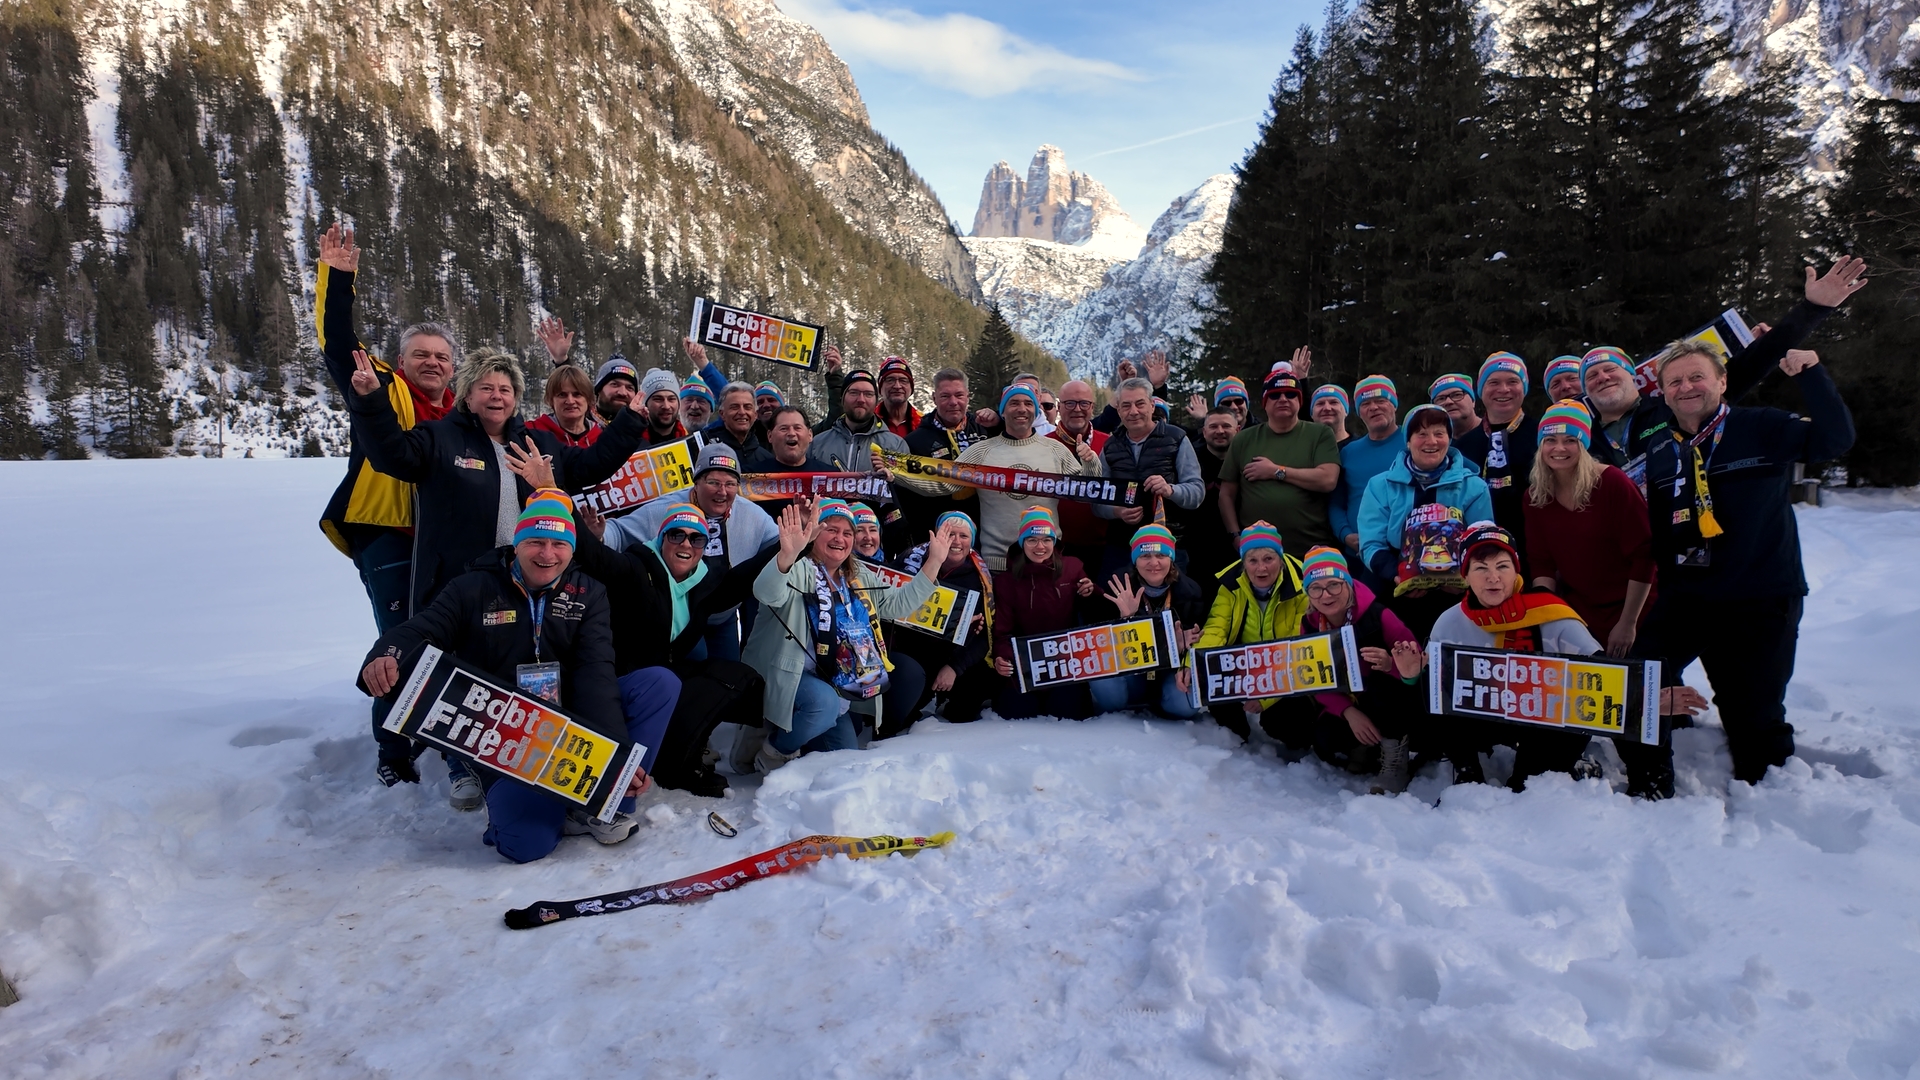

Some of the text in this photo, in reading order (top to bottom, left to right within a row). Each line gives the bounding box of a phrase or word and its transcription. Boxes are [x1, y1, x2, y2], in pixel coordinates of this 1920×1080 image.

[723, 311, 803, 342] Bobteam
[582, 450, 677, 490] bteam
[907, 459, 1007, 489] Bobteam
[1013, 472, 1117, 501] Friedrich
[1043, 628, 1139, 657] Bobteam
[1219, 645, 1314, 672] Bobteam
[393, 653, 437, 726] www.bobteam-friedrich.de
[1473, 658, 1603, 692] Bobteam
[462, 683, 594, 761] Bobteam
[1455, 679, 1624, 727] Friedrich
[1645, 665, 1655, 740] www.bobteam-friedrich.de
[425, 699, 599, 799] Friedrich
[603, 749, 640, 817] www.bobteam-friedrich.de
